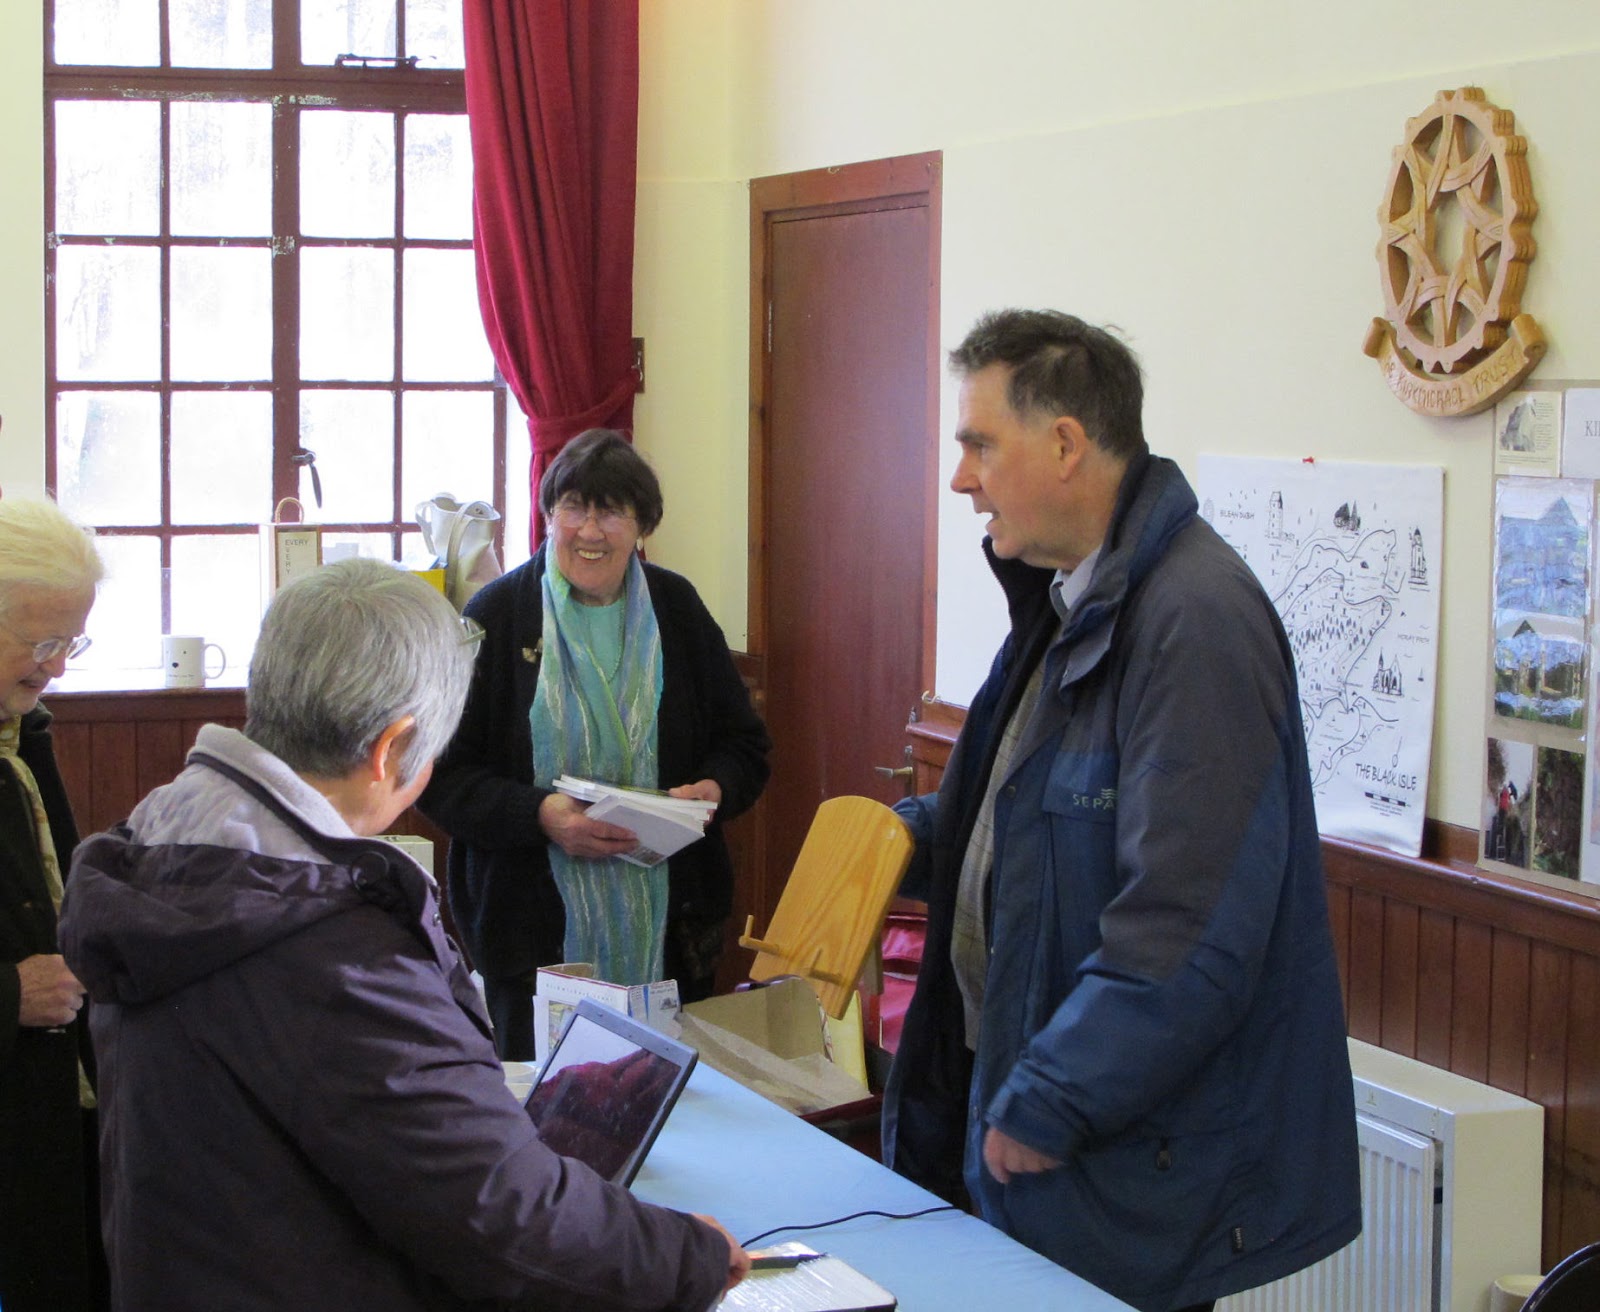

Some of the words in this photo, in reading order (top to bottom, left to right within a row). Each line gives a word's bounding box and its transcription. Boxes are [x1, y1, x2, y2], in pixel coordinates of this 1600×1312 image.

[1471, 344, 1521, 394] TRUST
[1584, 420, 1600, 437] KI
[1355, 762, 1371, 780] THE
[1371, 766, 1397, 786] BLACK
[1398, 773, 1417, 791] ISLE
[1072, 793, 1115, 810] SEPA
